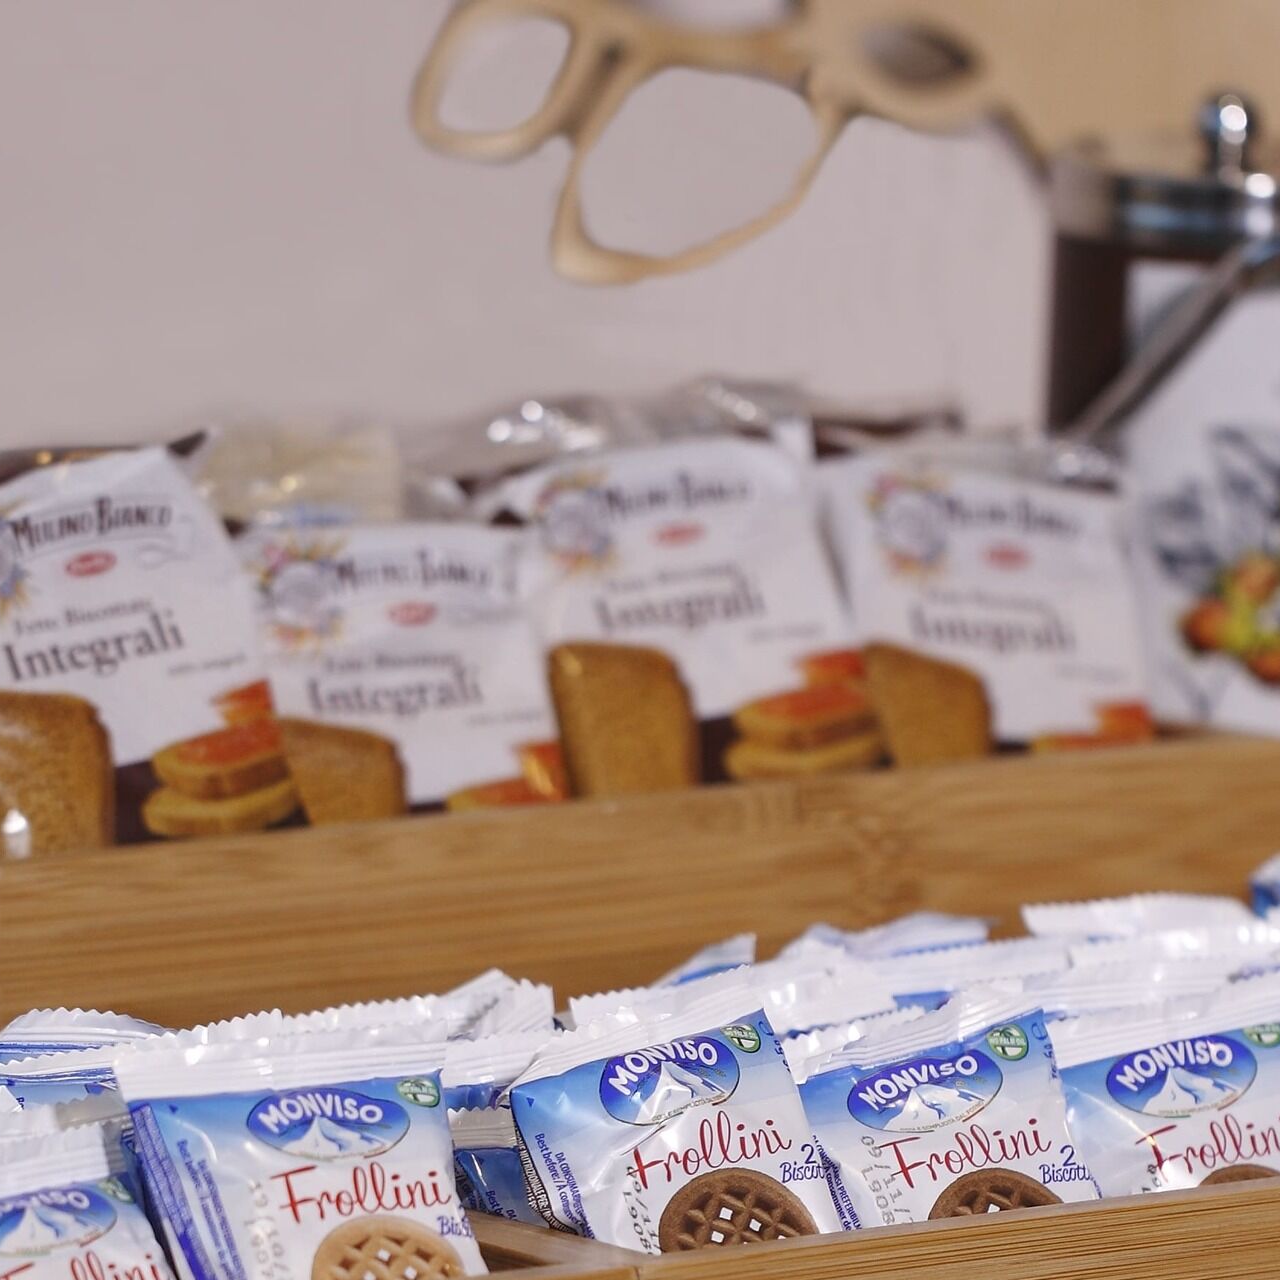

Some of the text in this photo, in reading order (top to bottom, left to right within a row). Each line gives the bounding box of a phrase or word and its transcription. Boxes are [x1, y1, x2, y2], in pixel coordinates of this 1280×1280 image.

[3, 606, 185, 681] Integrali
[608, 1036, 719, 1097] MONVISO
[858, 1054, 979, 1111] MONVISO
[1115, 1038, 1234, 1093] MONVISO
[258, 1092, 384, 1134] MONVISO
[535, 1133, 549, 1153] Best
[801, 1143, 815, 1165] 2
[878, 1117, 1052, 1190] Frollini
[1059, 1144, 1077, 1167] 2
[270, 1161, 453, 1224] Frollini
[860, 1135, 914, 1224] 09/11/
